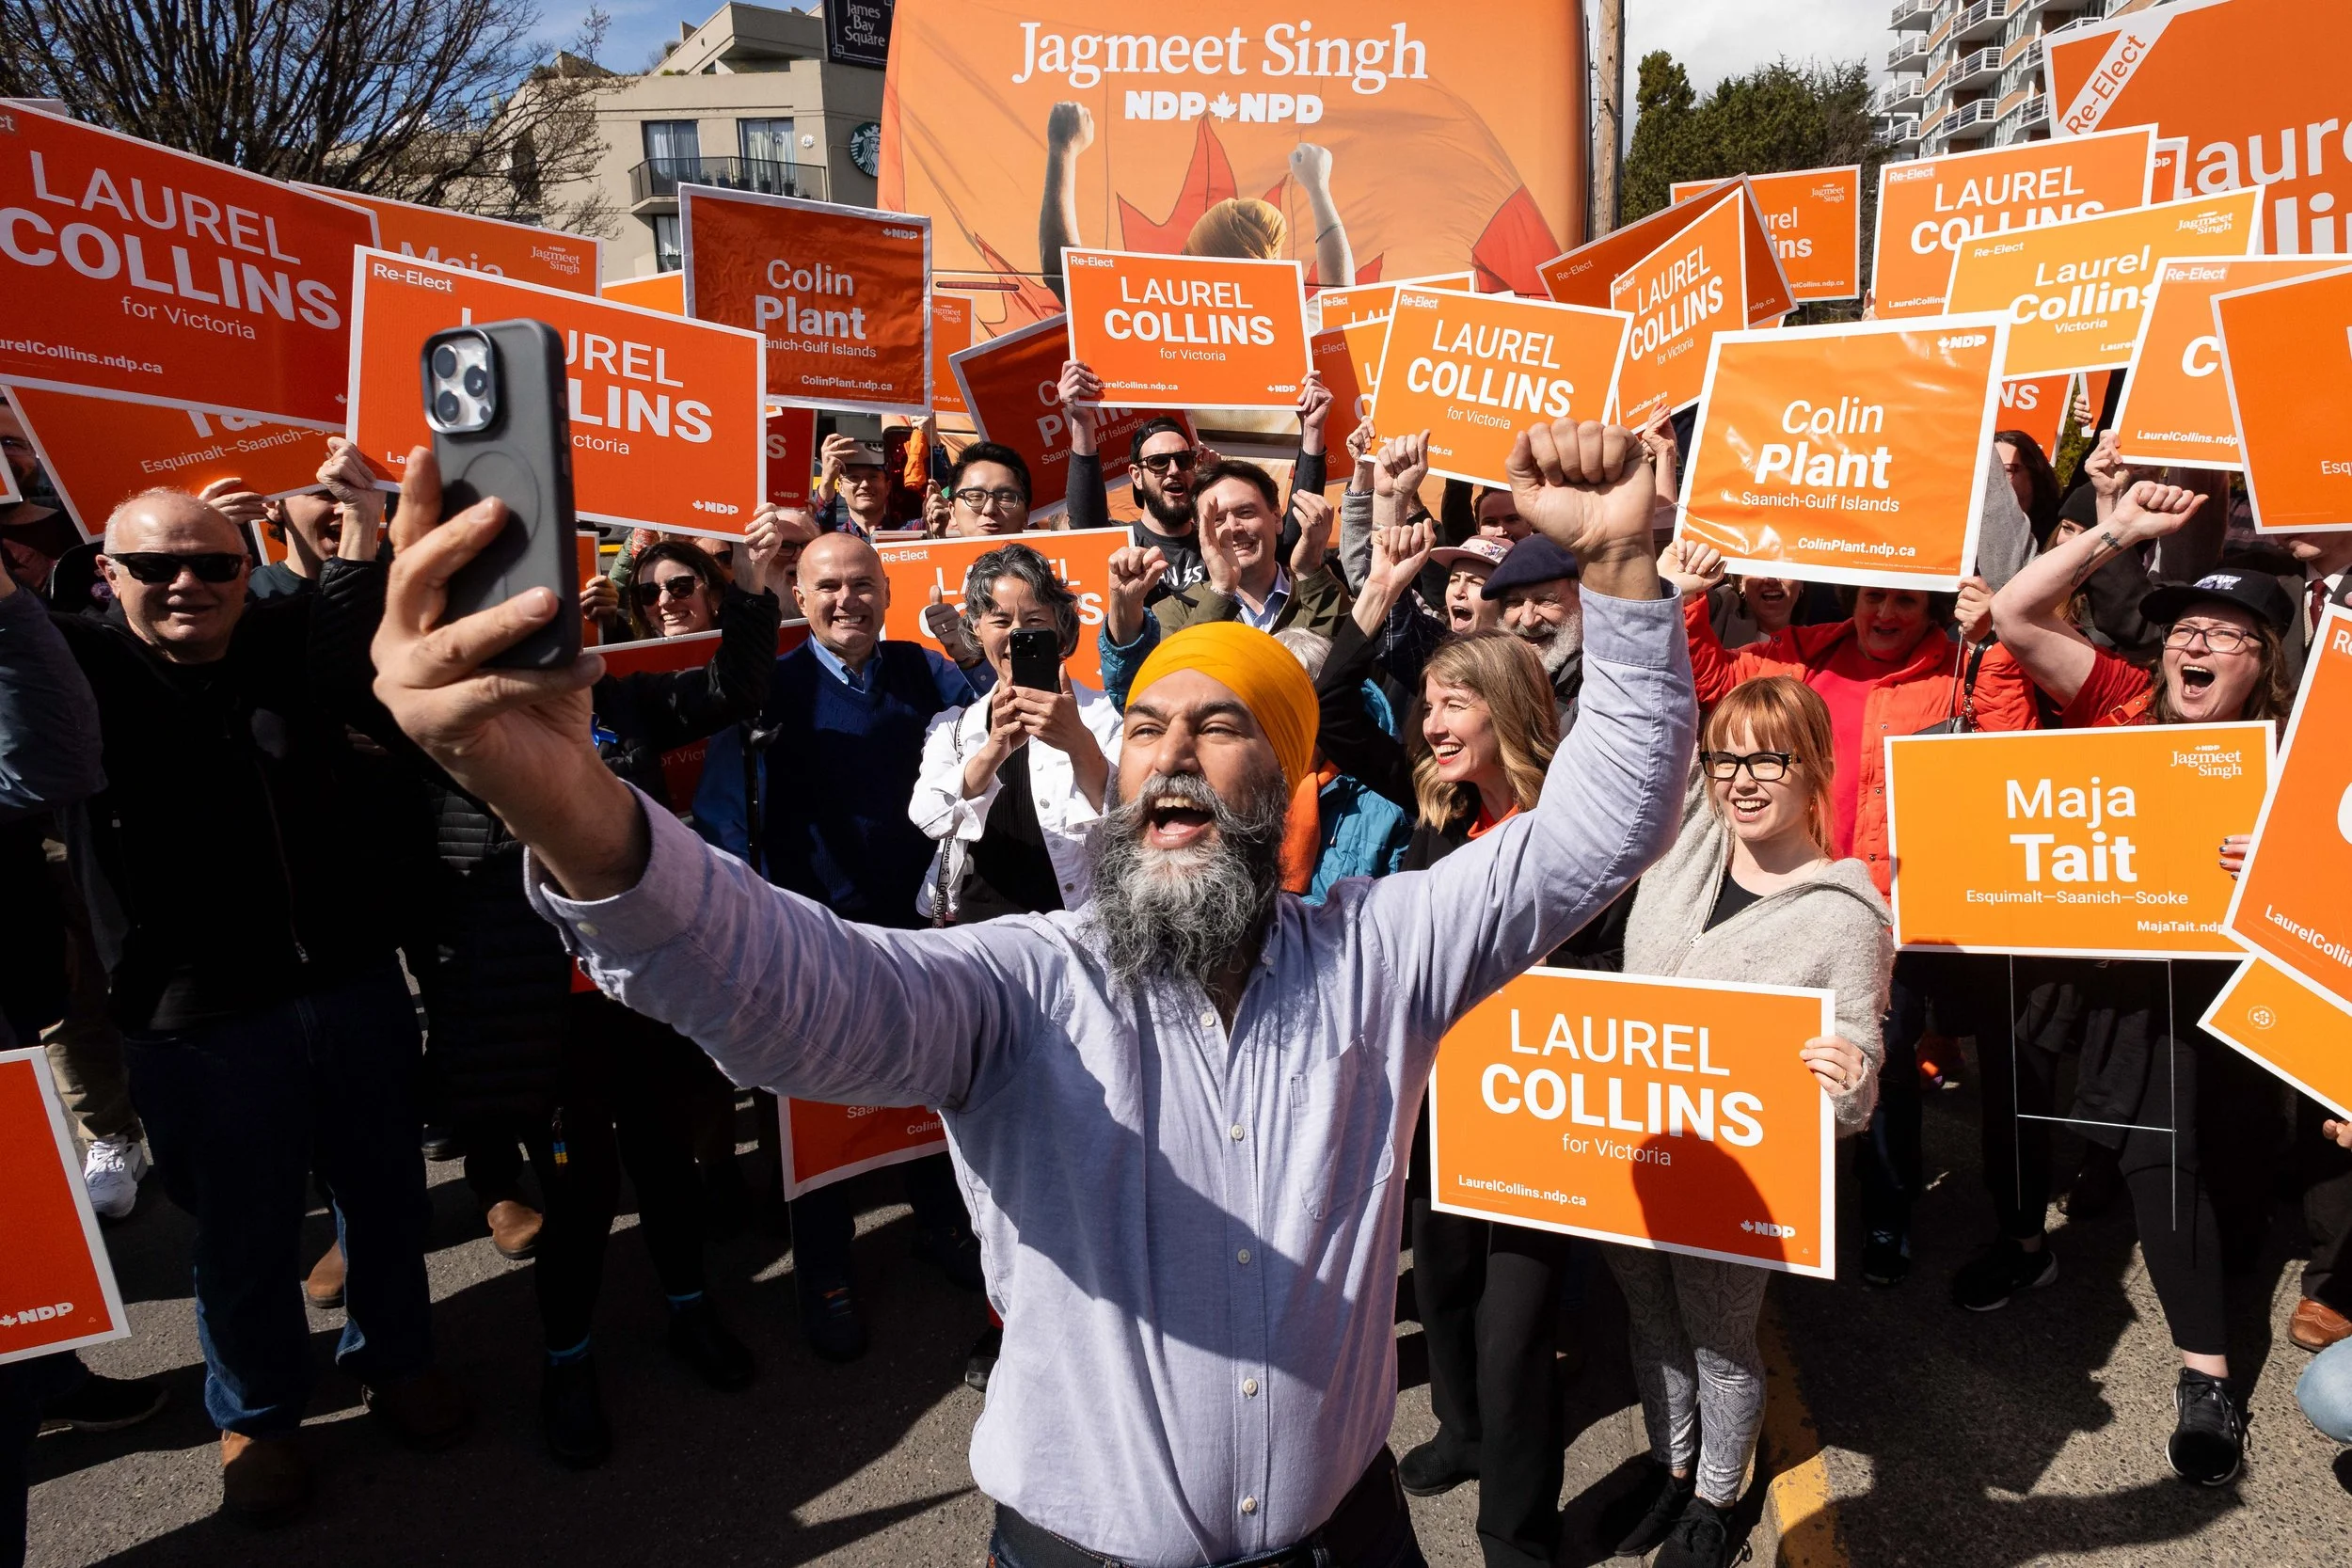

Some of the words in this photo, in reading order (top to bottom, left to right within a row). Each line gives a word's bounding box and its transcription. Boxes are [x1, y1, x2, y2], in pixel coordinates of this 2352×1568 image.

[847, 2, 881, 19] James
[853, 14, 875, 35] Bay
[845, 25, 885, 47] Square
[1011, 22, 1248, 89] Jagmeet
[1262, 20, 1429, 95] Singh
[2066, 34, 2146, 135] Re-Elect
[1124, 90, 1206, 121] NDP
[1239, 92, 1324, 124] NPD
[2153, 157, 2171, 168] DP
[1888, 166, 1934, 183] Re-Elect
[1810, 186, 1845, 198] Jagmeet
[1823, 194, 1845, 203] Singh
[1934, 165, 2085, 214] LAUREL
[30, 150, 301, 265] LAUREL
[2175, 213, 2233, 232] Jagmeet
[2196, 221, 2232, 235] Singh
[893, 229, 918, 241] NDP
[530, 245, 580, 265] Jagmeet
[1974, 242, 2025, 258] Re-Elect
[0, 207, 342, 331] COLLINS
[549, 260, 580, 276] Singh
[1071, 255, 1115, 269] Re-Elect
[1556, 259, 1595, 282] Re-Elect
[2035, 245, 2151, 288] Laurel
[373, 261, 453, 293] Re-Elect
[768, 259, 854, 297] Colin
[1637, 245, 1711, 317] LAUREL
[1790, 279, 1845, 289] relCollins.ndp.ca
[2166, 266, 2227, 282] Re-Elect
[1120, 276, 1254, 309] LAUREL
[1614, 275, 1636, 297] Re-Elect
[932, 307, 961, 317] agmeet
[1323, 296, 1348, 308] Re-Elect
[1400, 293, 1438, 310] Re-Elect
[1888, 295, 1947, 309] LaurelCollins
[121, 296, 157, 322] for
[164, 305, 256, 341] Victoria
[755, 294, 866, 341] Plant
[942, 314, 961, 324] Singh
[1104, 309, 1275, 346] COLLINS
[1630, 276, 1724, 361] COLLINS
[2055, 318, 2108, 335] Victoria
[766, 339, 829, 355] anich-Gulf
[832, 344, 877, 359] Islands
[1312, 341, 1347, 356] e-Elect
[1432, 319, 1563, 371] LAUREL
[1657, 352, 1667, 366] for
[1667, 337, 1694, 360] Victoria
[1949, 334, 1988, 350] NDP
[0, 339, 164, 375] urelCollins.ndp.ca
[1159, 347, 1177, 360] for
[1180, 349, 1227, 361] Victoria
[801, 375, 893, 392] ColinPlant.ndp.ca
[1099, 380, 1178, 392] aurelCollins.ndp.ca
[1275, 385, 1297, 393] NDP
[1407, 356, 1575, 419] COLLINS
[567, 378, 712, 444] LINS
[1446, 405, 1466, 421] for
[1467, 409, 1512, 431] Victoria
[1781, 395, 1884, 436] Colin
[1109, 417, 1145, 440] Islands
[2137, 429, 2239, 446] LaurelCollins.ndp
[571, 431, 630, 456] ctoria
[1754, 441, 1893, 489] Plant
[704, 500, 739, 515] NDP
[1740, 491, 1837, 511] Saanich-Gulf
[1840, 494, 1900, 513] Islands
[881, 549, 929, 563] Re-Elect
[1797, 537, 1916, 558] ColinPlant.ndp.ca
[2170, 750, 2242, 768] Jagmeet
[2198, 763, 2243, 780] Singh
[2006, 776, 2137, 830] Maja
[2009, 831, 2137, 883] Tait
[2137, 920, 2226, 936] MajaTait.ndp
[1510, 1008, 1730, 1077] LAUREL
[1480, 1063, 1764, 1148] COLLINS
[1562, 1132, 1590, 1155] for
[1595, 1136, 1672, 1167] Victoria
[1458, 1173, 1587, 1207] LaurelCollins.ndp.ca
[1755, 1221, 1796, 1240] NDP
[16, 1302, 74, 1325] NDP
